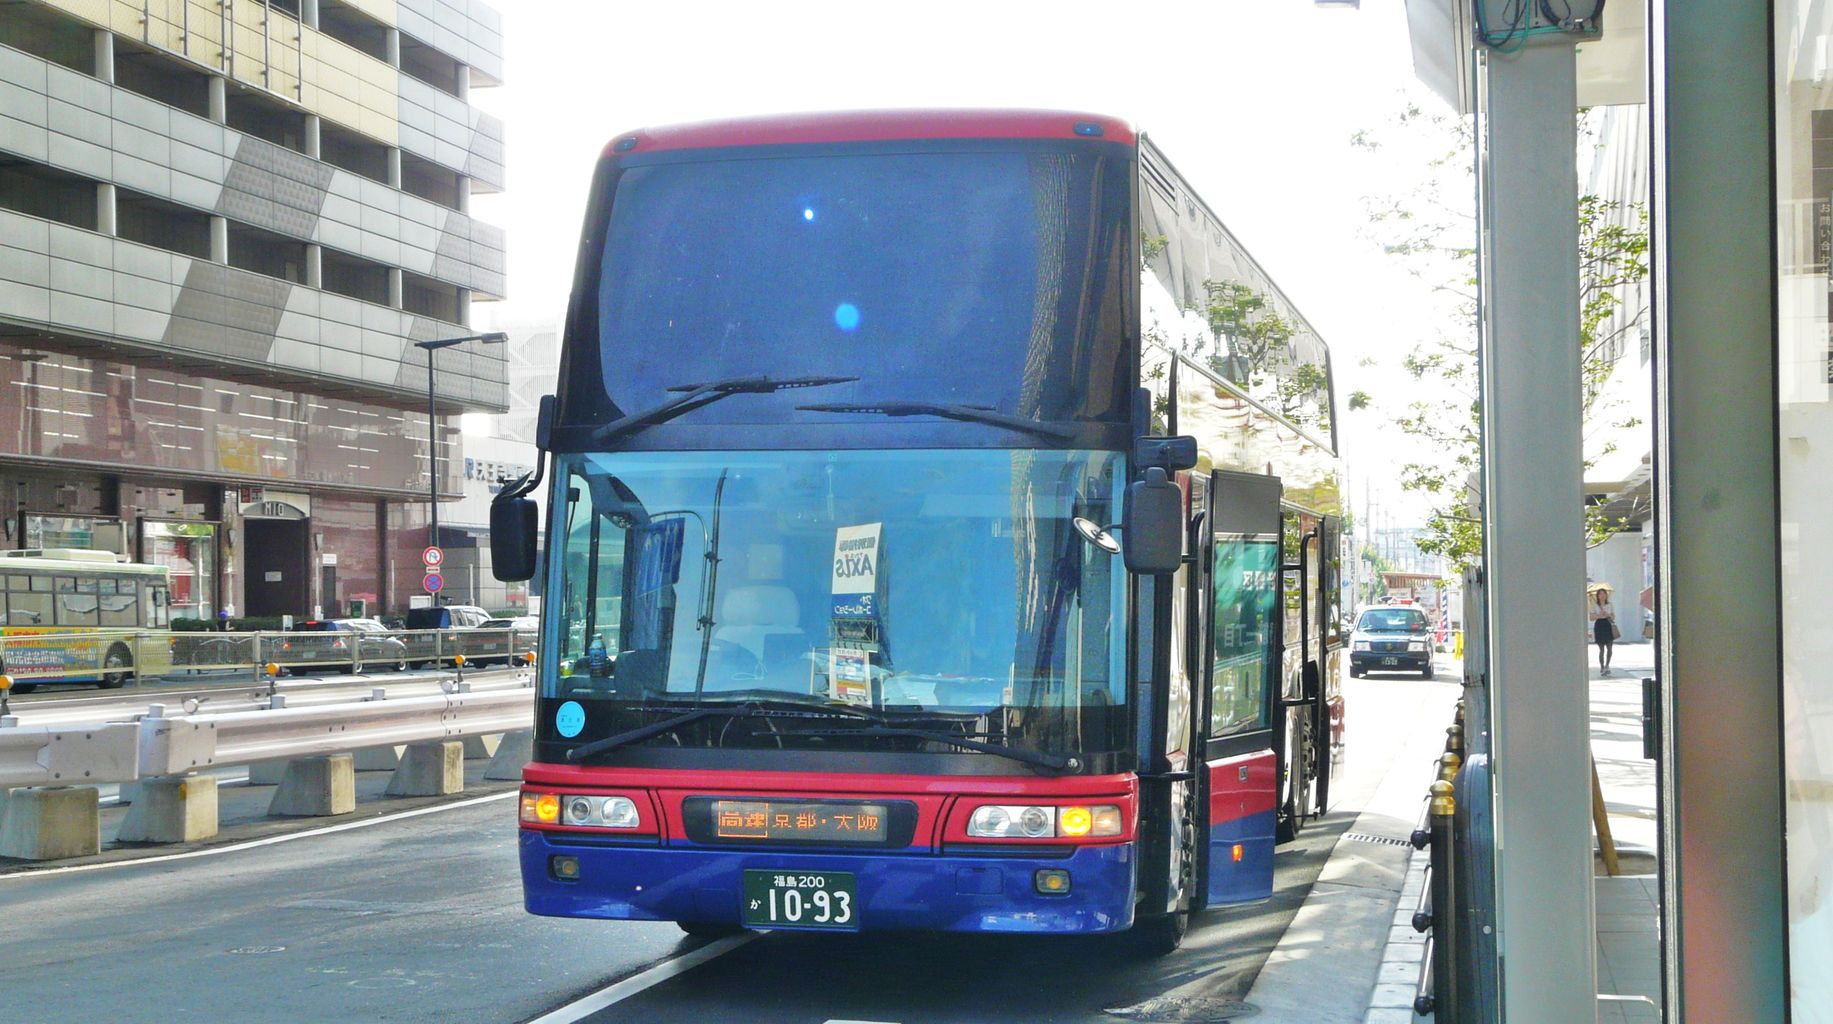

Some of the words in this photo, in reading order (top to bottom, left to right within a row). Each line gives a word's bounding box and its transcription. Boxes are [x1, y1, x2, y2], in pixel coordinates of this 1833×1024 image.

[264, 502, 285, 516] MIO
[750, 898, 762, 910] か
[769, 888, 851, 923] 10-93
